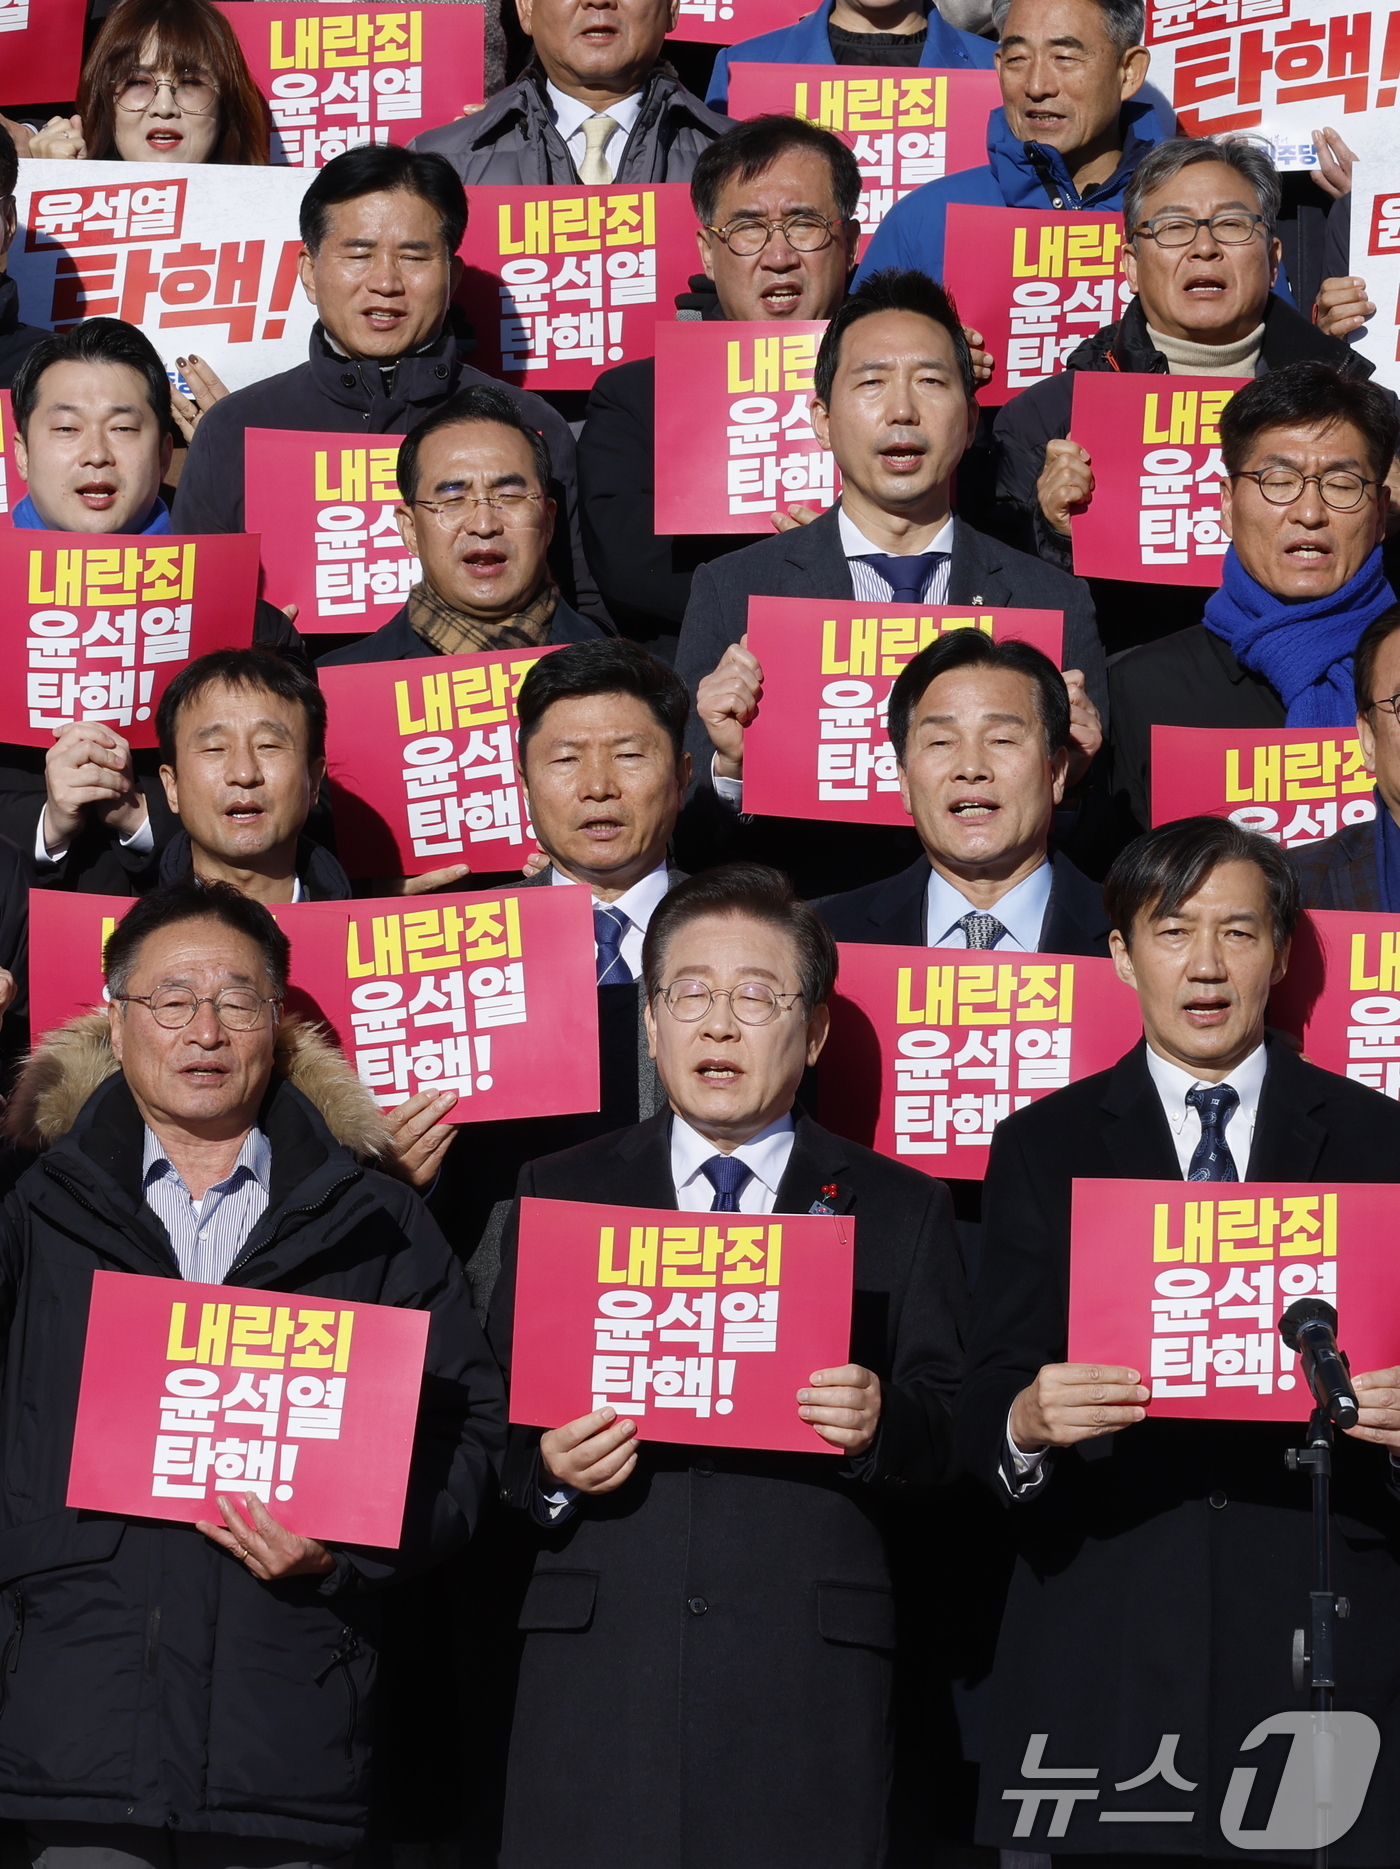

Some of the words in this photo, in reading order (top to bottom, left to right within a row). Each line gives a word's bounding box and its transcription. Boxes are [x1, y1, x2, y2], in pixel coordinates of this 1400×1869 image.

[270, 11, 422, 69] 내란죄
[269, 66, 422, 127] 윤석열
[795, 76, 948, 131] 내란죄
[1173, 11, 1400, 139] 탄핵!
[853, 131, 946, 186] 석열
[35, 185, 179, 244] 윤석열
[498, 191, 656, 255] 내란죄
[498, 249, 657, 314] 윤석열
[1012, 224, 1125, 278] 내란
[51, 239, 304, 343] 탄핵!
[500, 311, 624, 371] 탄핵!
[727, 451, 843, 515] 탄핵
[28, 543, 196, 606] 내란죄
[315, 557, 423, 617] 탄핵
[26, 604, 192, 668] 윤석열
[27, 670, 155, 729] 탄핵!
[402, 725, 520, 799] 윤석
[347, 897, 522, 978] 내란죄
[350, 962, 526, 1045] 윤석열
[897, 964, 1074, 1025] 내란죄
[355, 1035, 493, 1107] 탄핵!
[895, 1028, 1071, 1091] 윤석열
[895, 1094, 1031, 1154] 탄핵
[597, 1224, 782, 1287] 내란죄
[1153, 1193, 1338, 1263] 내란죄
[594, 1290, 779, 1353] 윤석열
[1151, 1261, 1337, 1333] 윤석열
[166, 1302, 354, 1372] 내란죄
[1151, 1332, 1296, 1398] 탄핵!
[159, 1368, 346, 1439] 윤석열
[591, 1355, 736, 1418] 탄핵!
[151, 1435, 299, 1503] 탄핵!
